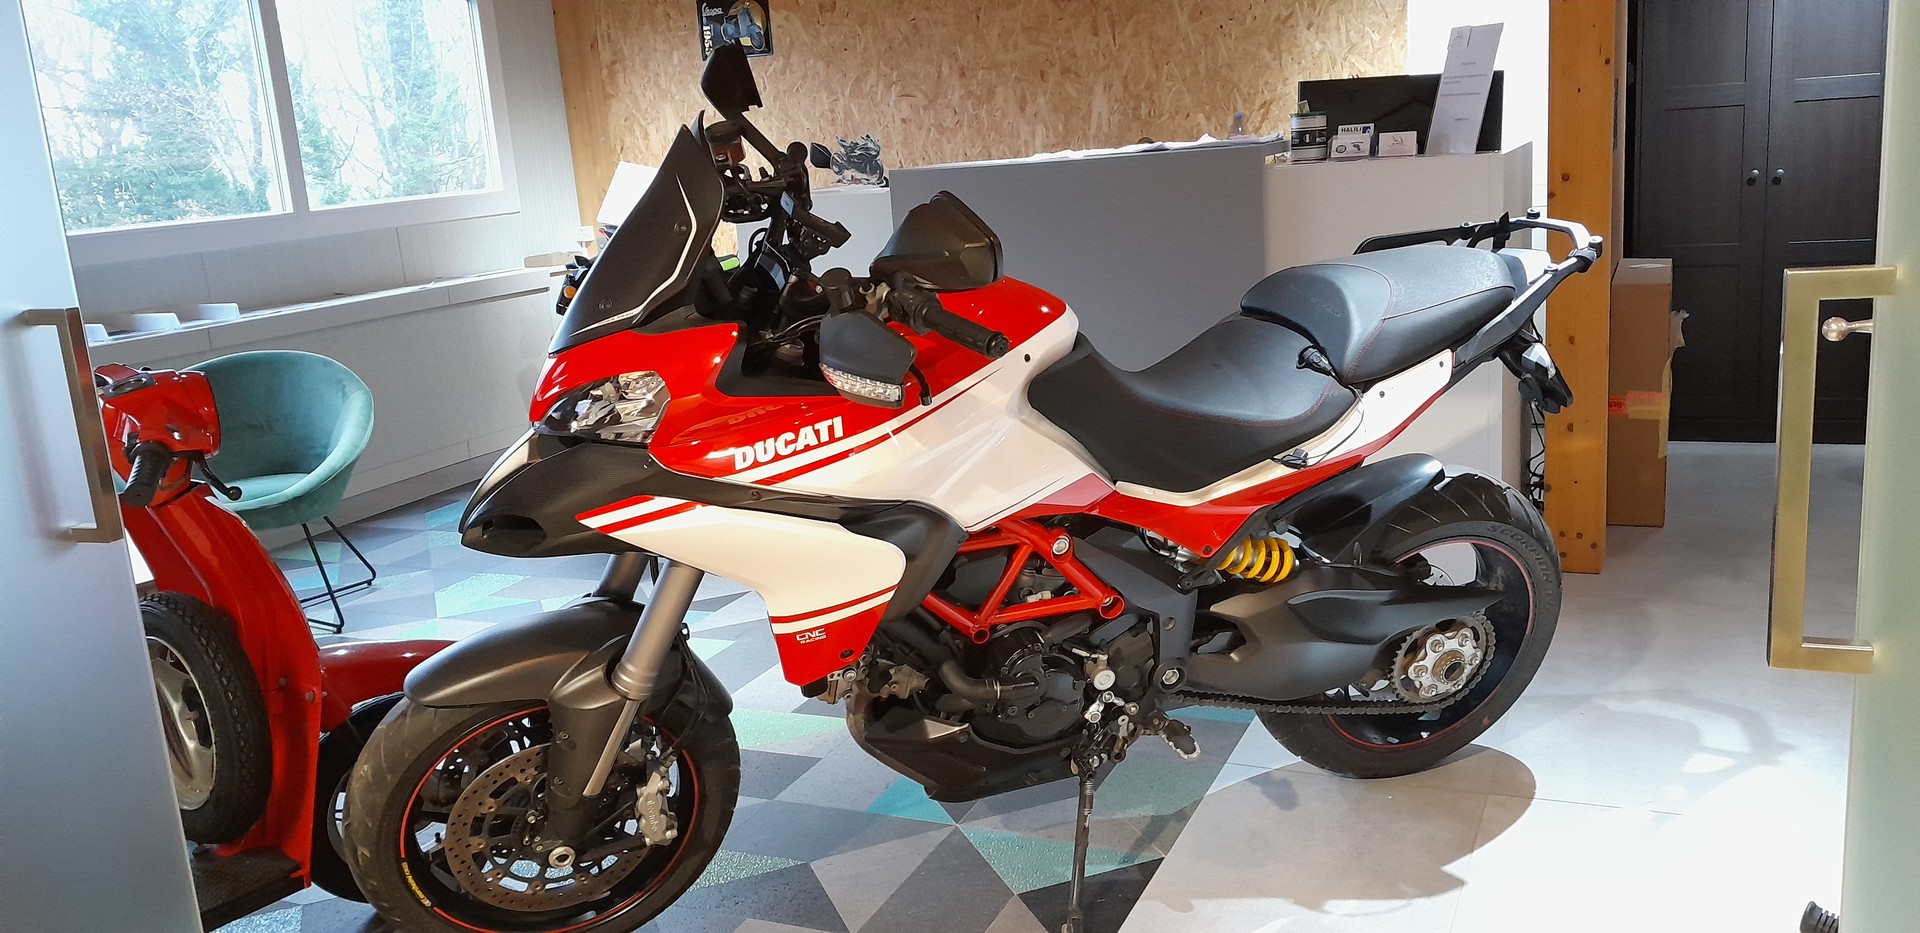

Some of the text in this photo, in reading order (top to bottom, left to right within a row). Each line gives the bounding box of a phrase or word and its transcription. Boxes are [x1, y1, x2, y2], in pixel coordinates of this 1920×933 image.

[702, 2, 724, 17] Vespa
[734, 416, 844, 470] DUCATI
[796, 628, 826, 640] CNC
[800, 635, 827, 644] RACING
